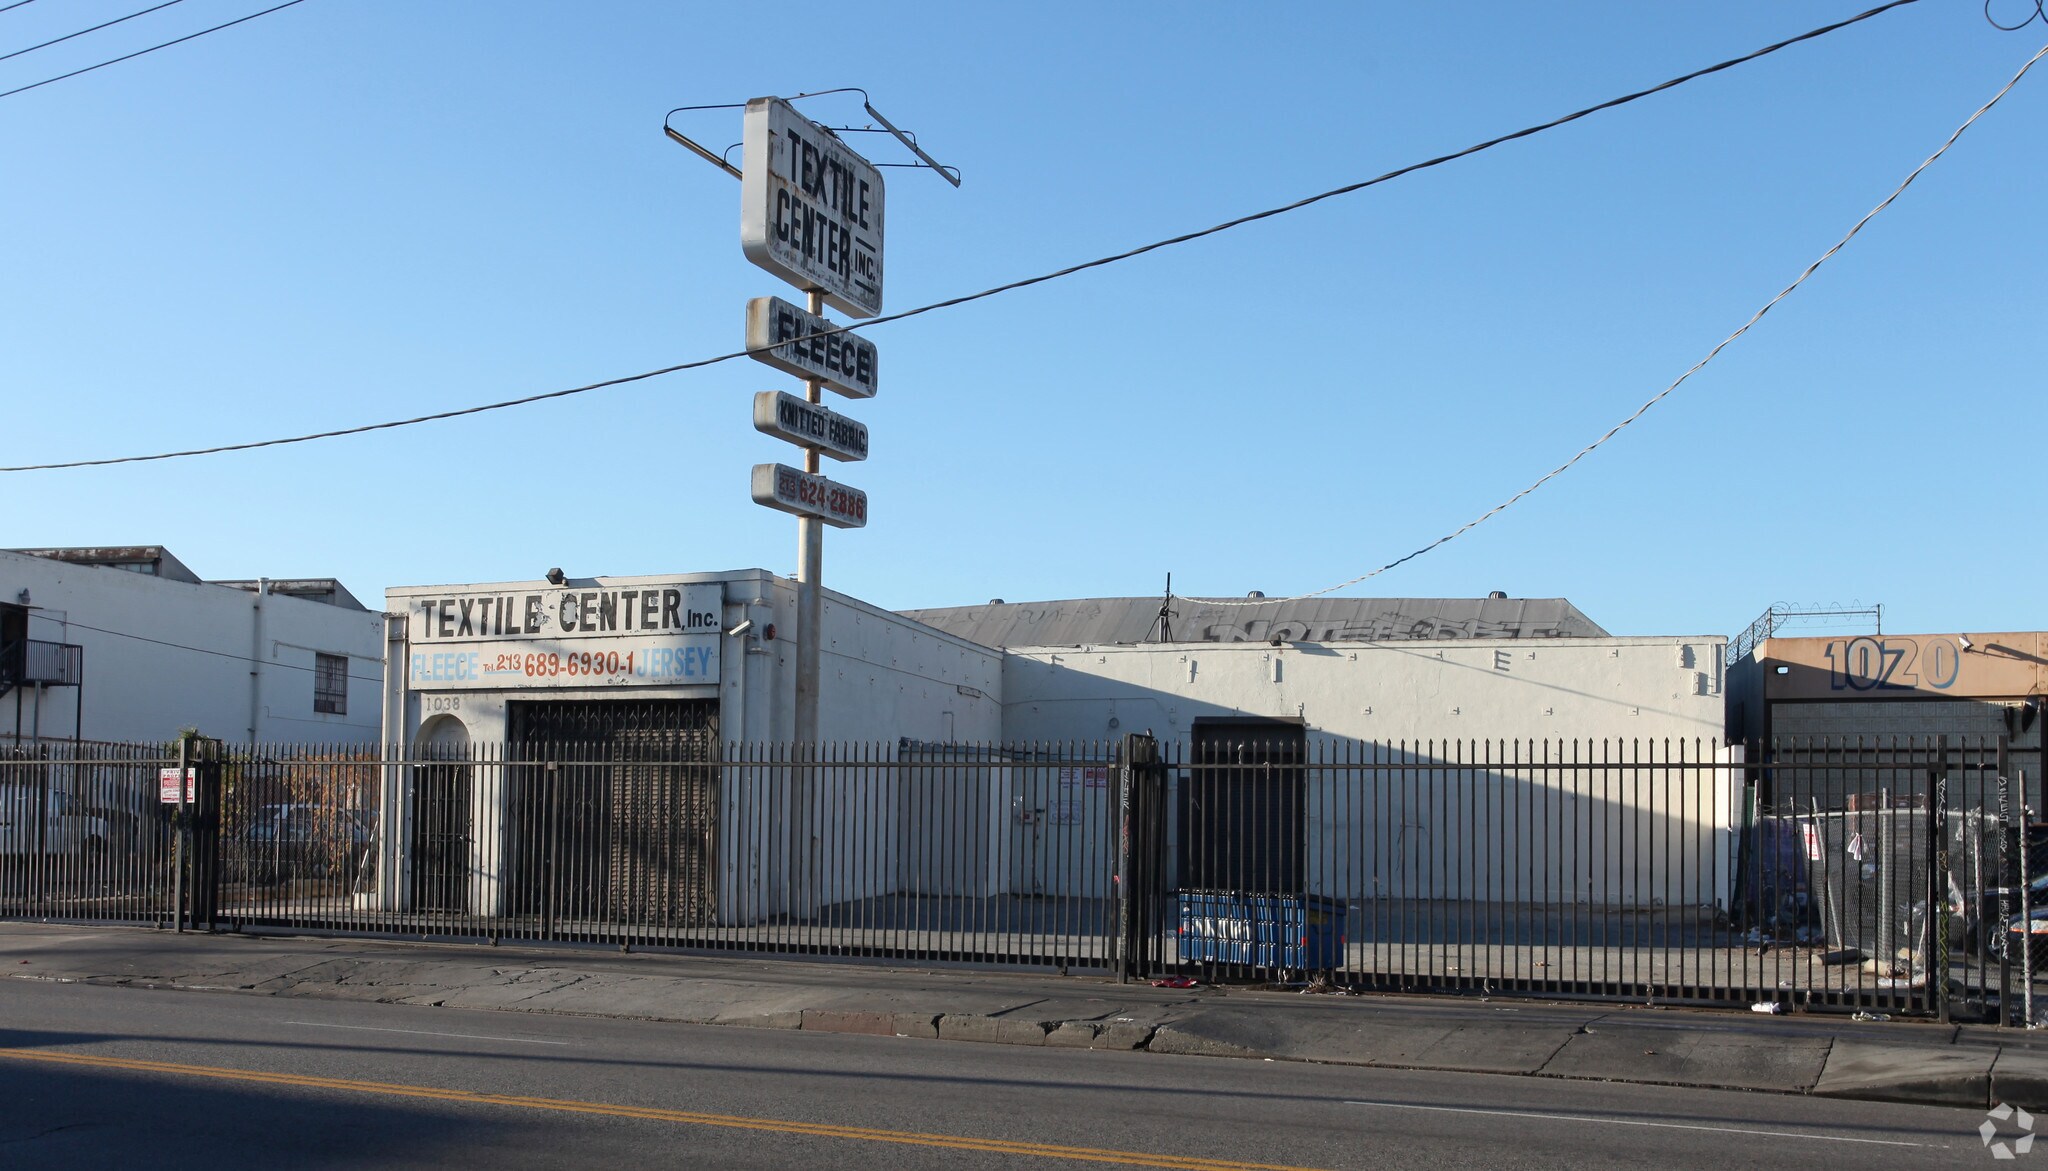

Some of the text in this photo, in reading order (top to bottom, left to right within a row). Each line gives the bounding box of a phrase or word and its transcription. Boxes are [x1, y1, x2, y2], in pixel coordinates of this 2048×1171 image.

[787, 127, 870, 231] TEXTILE
[775, 187, 876, 282] CENTER INC.
[777, 309, 871, 386] FLEECE
[780, 399, 866, 453] KNITTED FABRIC
[420, 595, 543, 638] TEXTILE
[687, 608, 718, 628] Inc.
[411, 651, 480, 683] FLEECE
[524, 649, 634, 678] 689-6930-1
[636, 645, 712, 679] JERSEY
[1823, 635, 1960, 692] 1020
[425, 696, 460, 712] 1038
